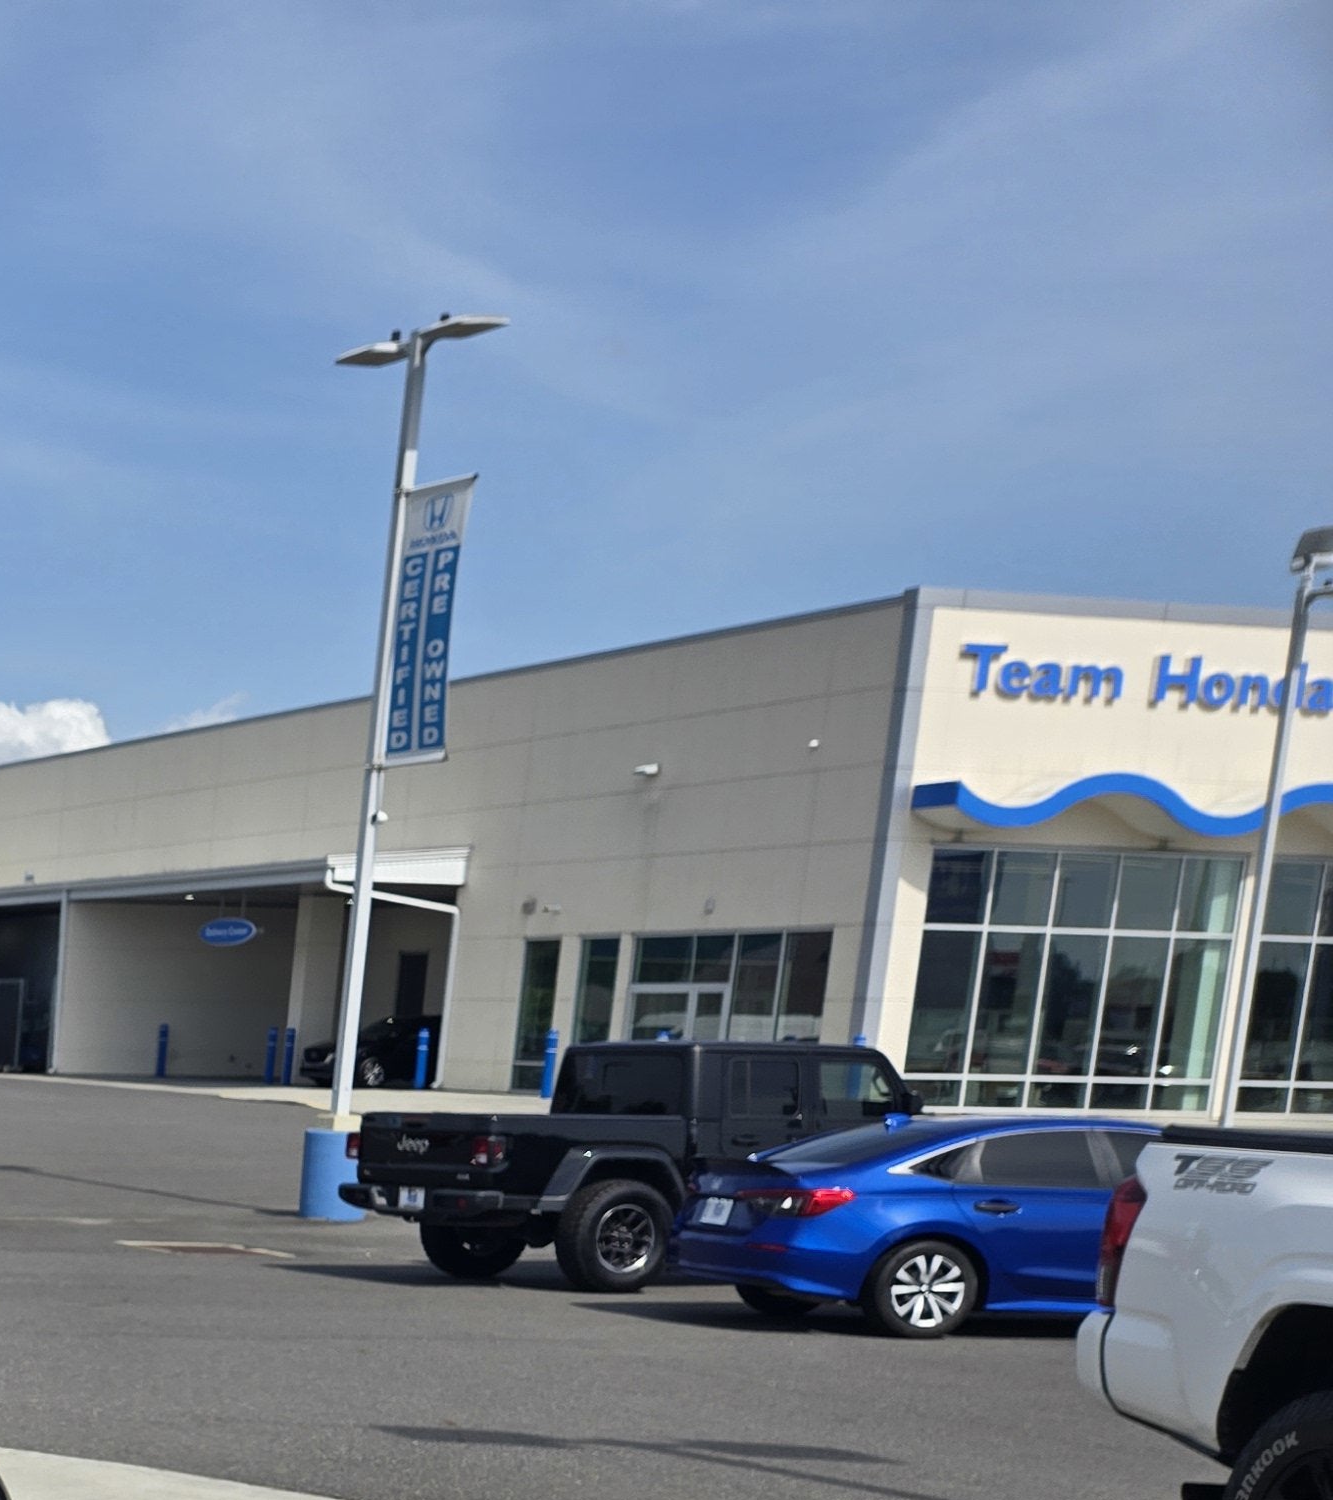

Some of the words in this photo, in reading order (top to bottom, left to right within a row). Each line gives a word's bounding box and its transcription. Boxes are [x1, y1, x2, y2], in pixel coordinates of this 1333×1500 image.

[430, 551, 454, 615] PRE
[390, 556, 424, 750] CERTIFIED
[962, 642, 1125, 702] Team
[1152, 654, 1333, 712] Honda
[421, 639, 446, 746] OWNED
[396, 1133, 430, 1154] Jeep
